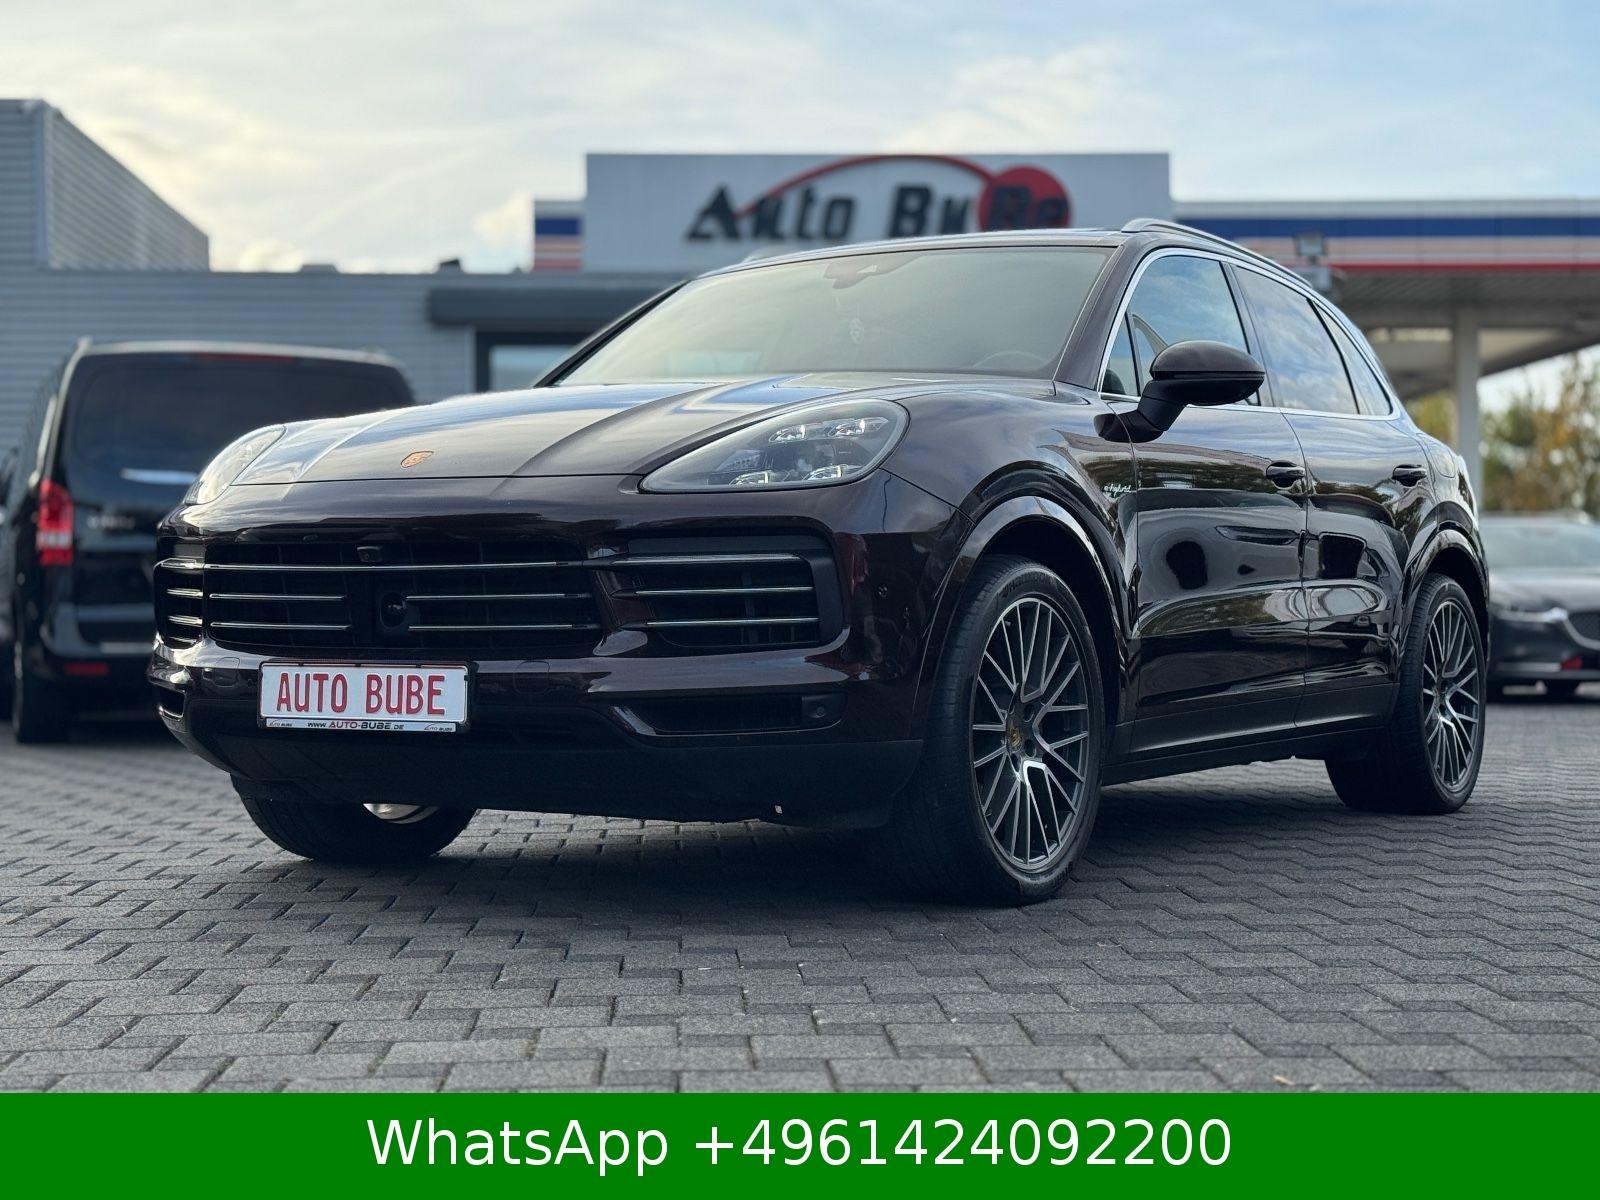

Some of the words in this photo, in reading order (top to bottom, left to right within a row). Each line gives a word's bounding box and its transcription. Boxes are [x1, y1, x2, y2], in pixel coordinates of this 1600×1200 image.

[687, 183, 856, 241] Auto
[276, 672, 348, 714] AUTO
[365, 673, 446, 716] BUBE
